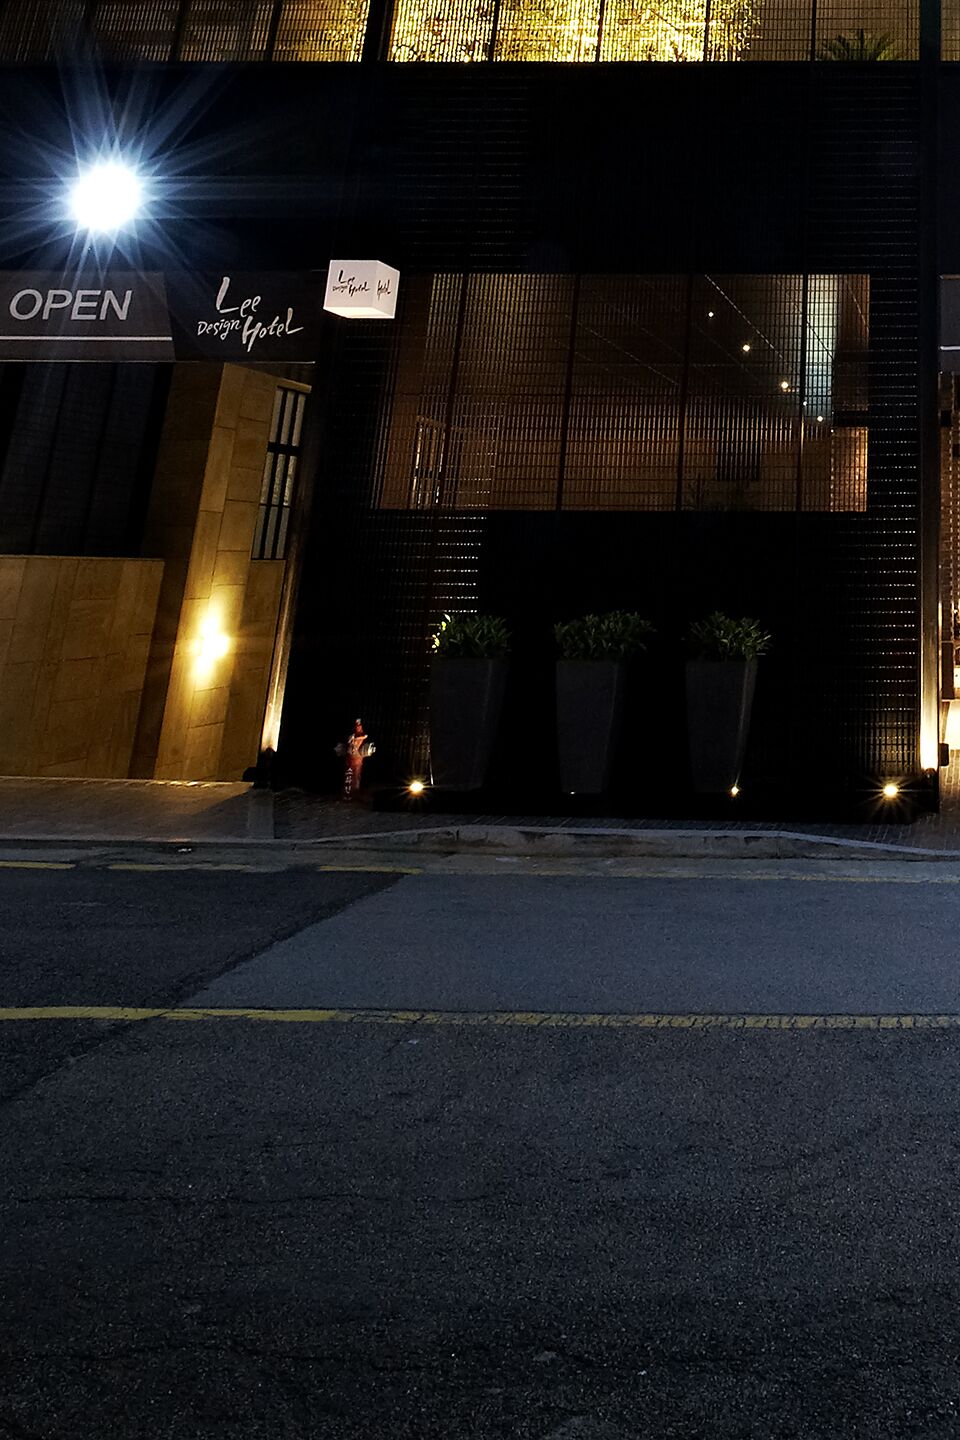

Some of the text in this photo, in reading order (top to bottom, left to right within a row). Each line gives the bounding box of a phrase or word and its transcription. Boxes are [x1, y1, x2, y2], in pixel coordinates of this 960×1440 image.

[9, 289, 132, 320] OPEN
[216, 276, 262, 317] Lee
[198, 318, 242, 340] Design
